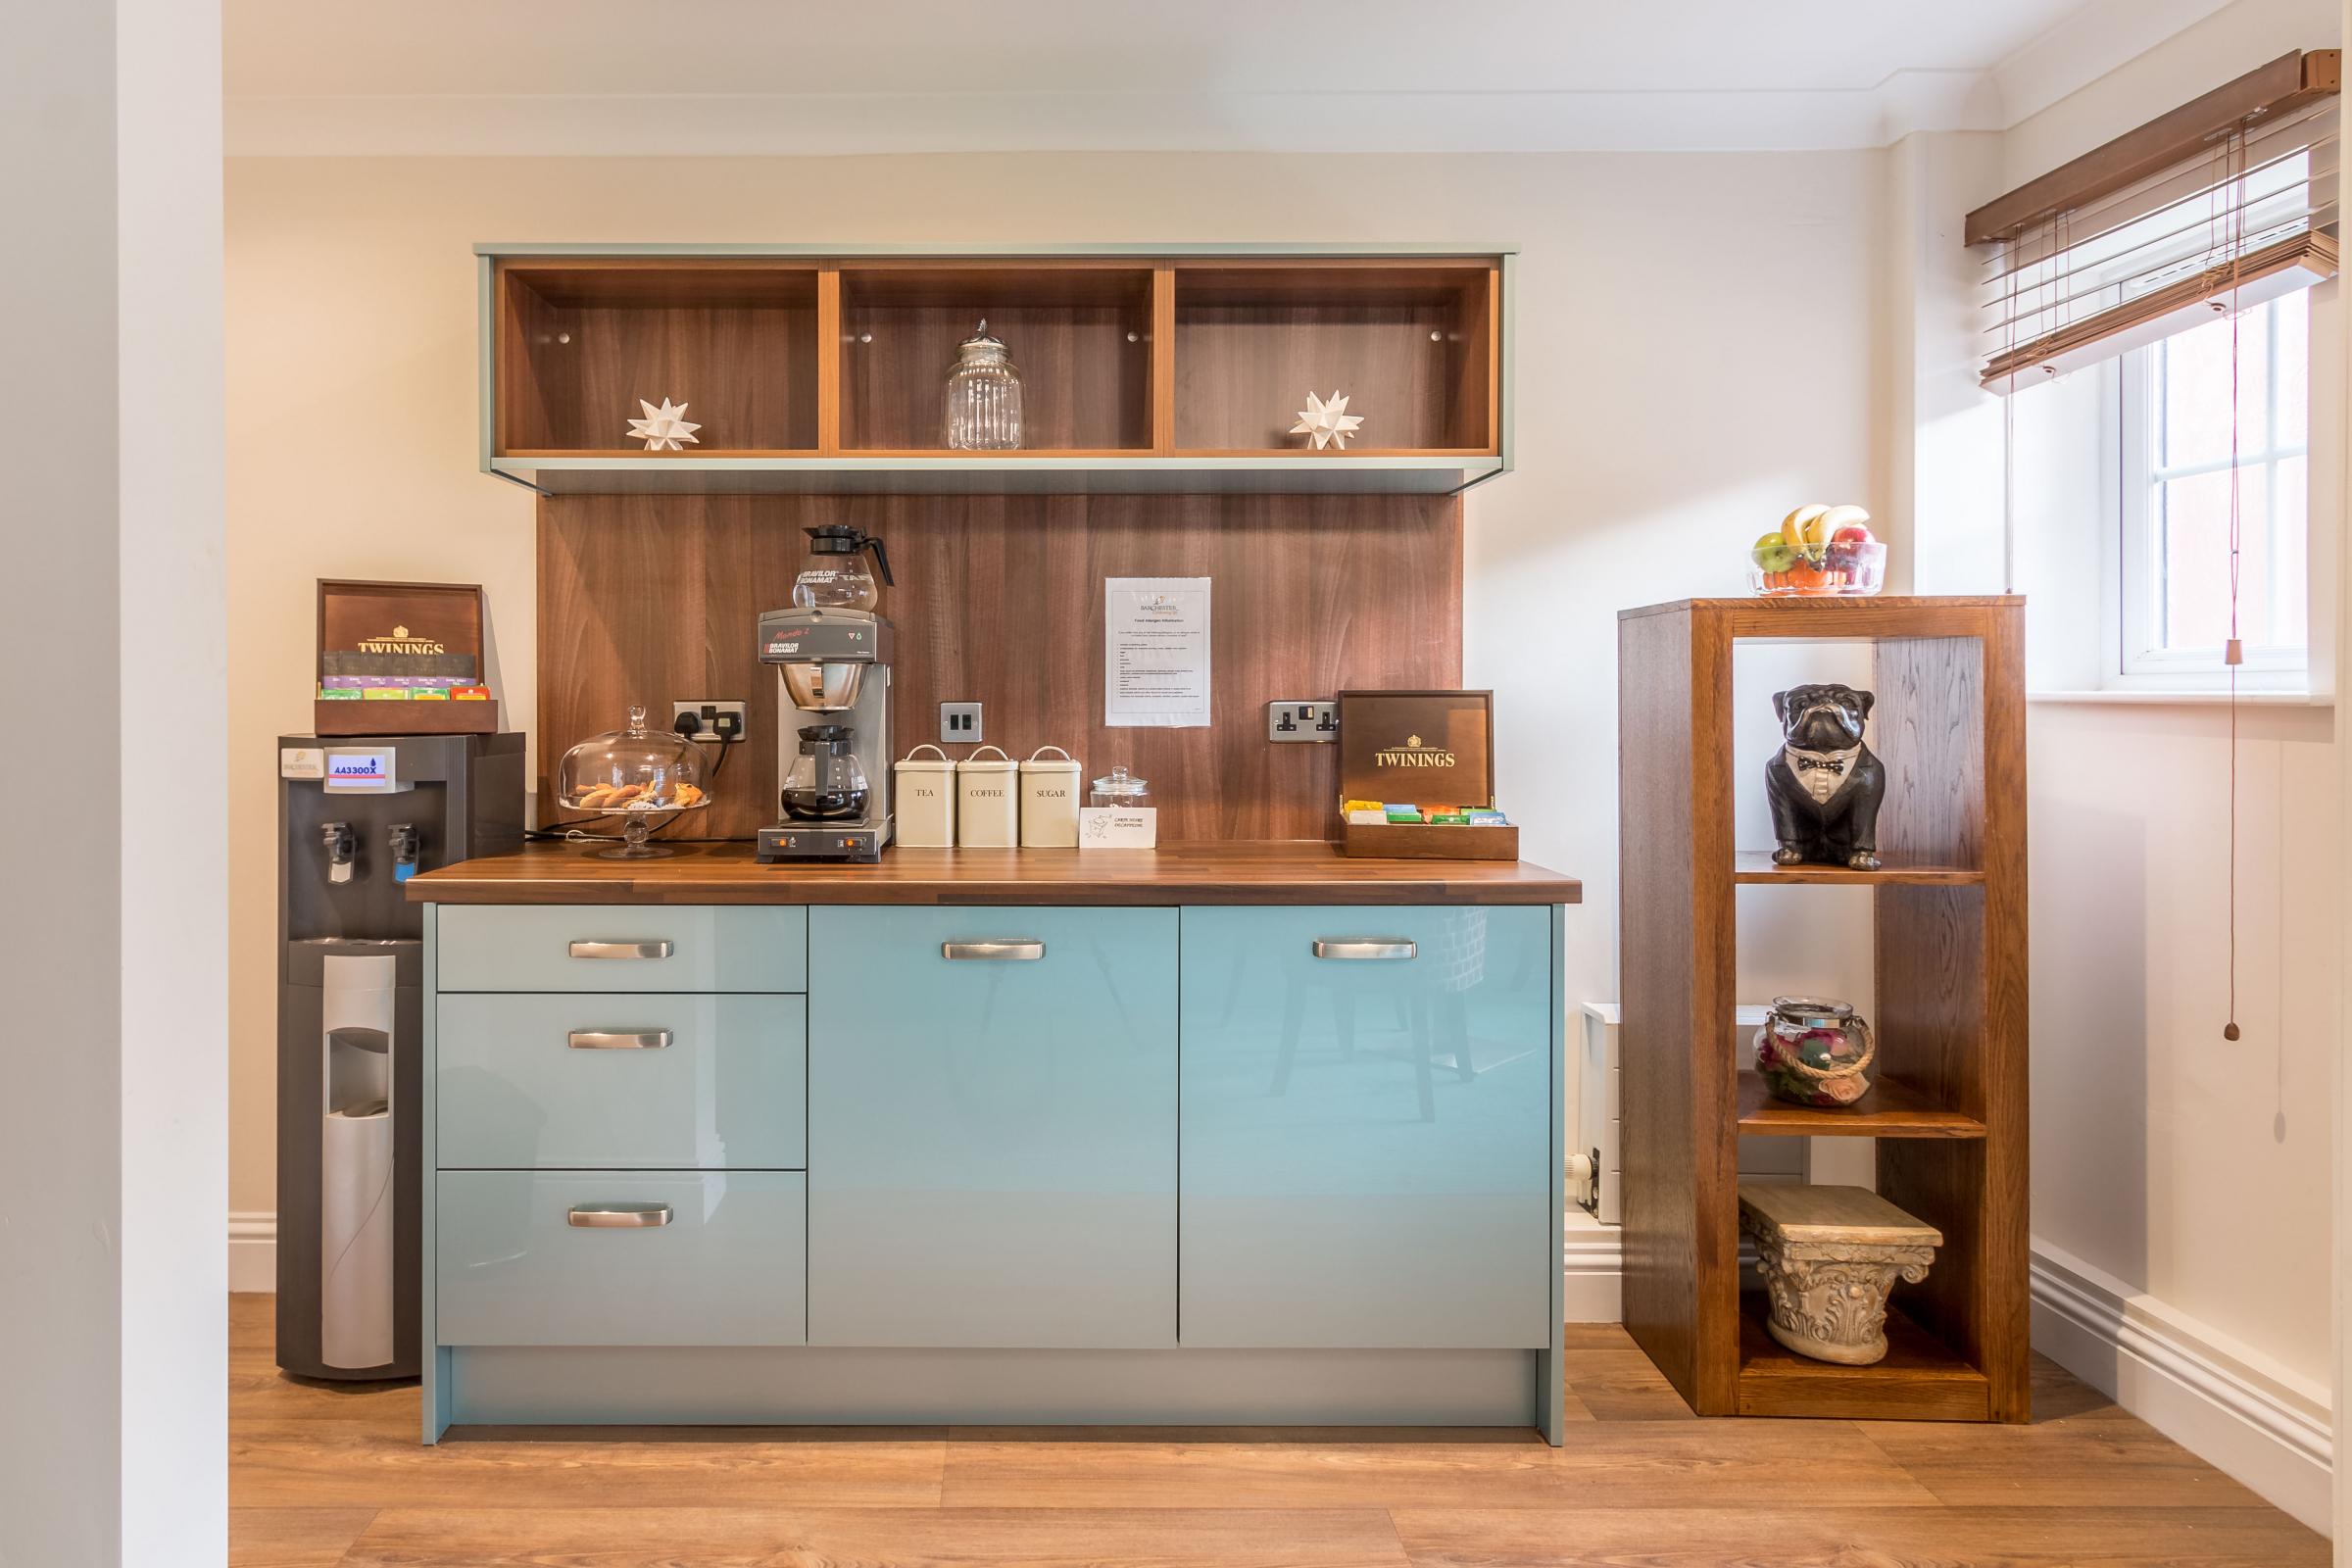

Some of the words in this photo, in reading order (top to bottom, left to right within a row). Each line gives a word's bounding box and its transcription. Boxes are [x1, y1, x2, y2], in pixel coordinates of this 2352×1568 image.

[358, 642, 444, 655] TWININGS
[1375, 753, 1455, 767] TWININGS
[334, 766, 376, 775] AA3300X
[970, 789, 1004, 798] COFFEE
[1036, 789, 1066, 798] SUGAR
